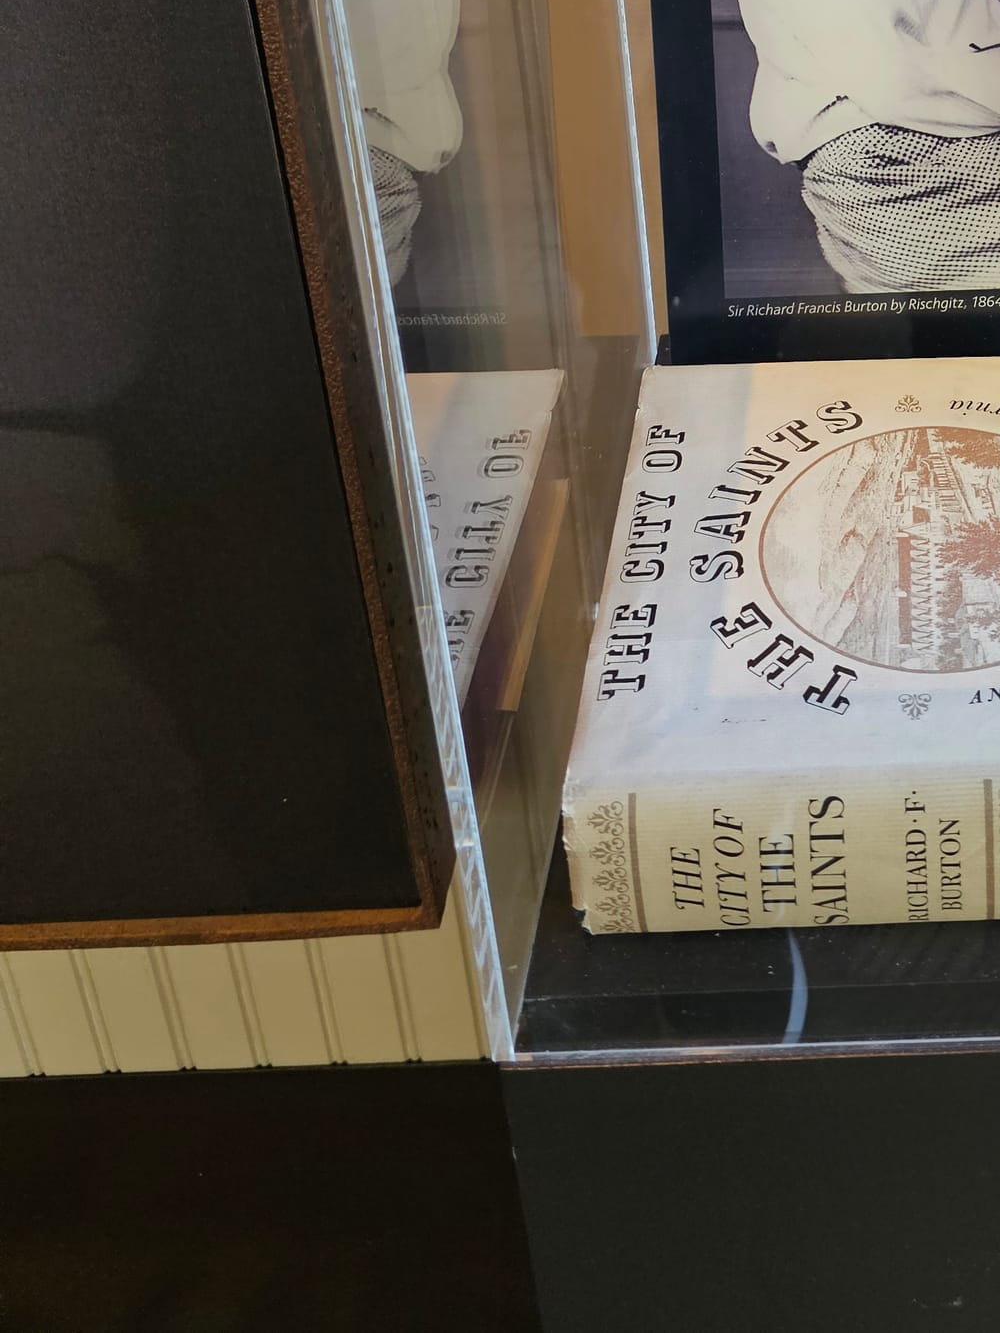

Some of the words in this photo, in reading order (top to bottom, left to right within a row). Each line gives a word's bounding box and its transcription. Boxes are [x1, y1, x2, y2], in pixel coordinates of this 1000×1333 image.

[728, 304, 745, 318] Sir
[746, 301, 796, 317] Richard
[797, 299, 842, 315] Francis
[844, 298, 888, 314] Burton
[890, 298, 906, 315] by
[909, 296, 968, 314] Rischgitz,
[641, 423, 686, 474] OF
[688, 399, 863, 584] SAINTS
[619, 490, 677, 584] CITY
[596, 603, 659, 702] THE
[709, 601, 859, 716] THE
[711, 807, 747, 859] OF
[758, 832, 800, 914] THE
[808, 794, 850, 926] SAINTS
[939, 817, 963, 913] BURTON
[670, 845, 706, 912] THE
[713, 864, 752, 928] CITY
